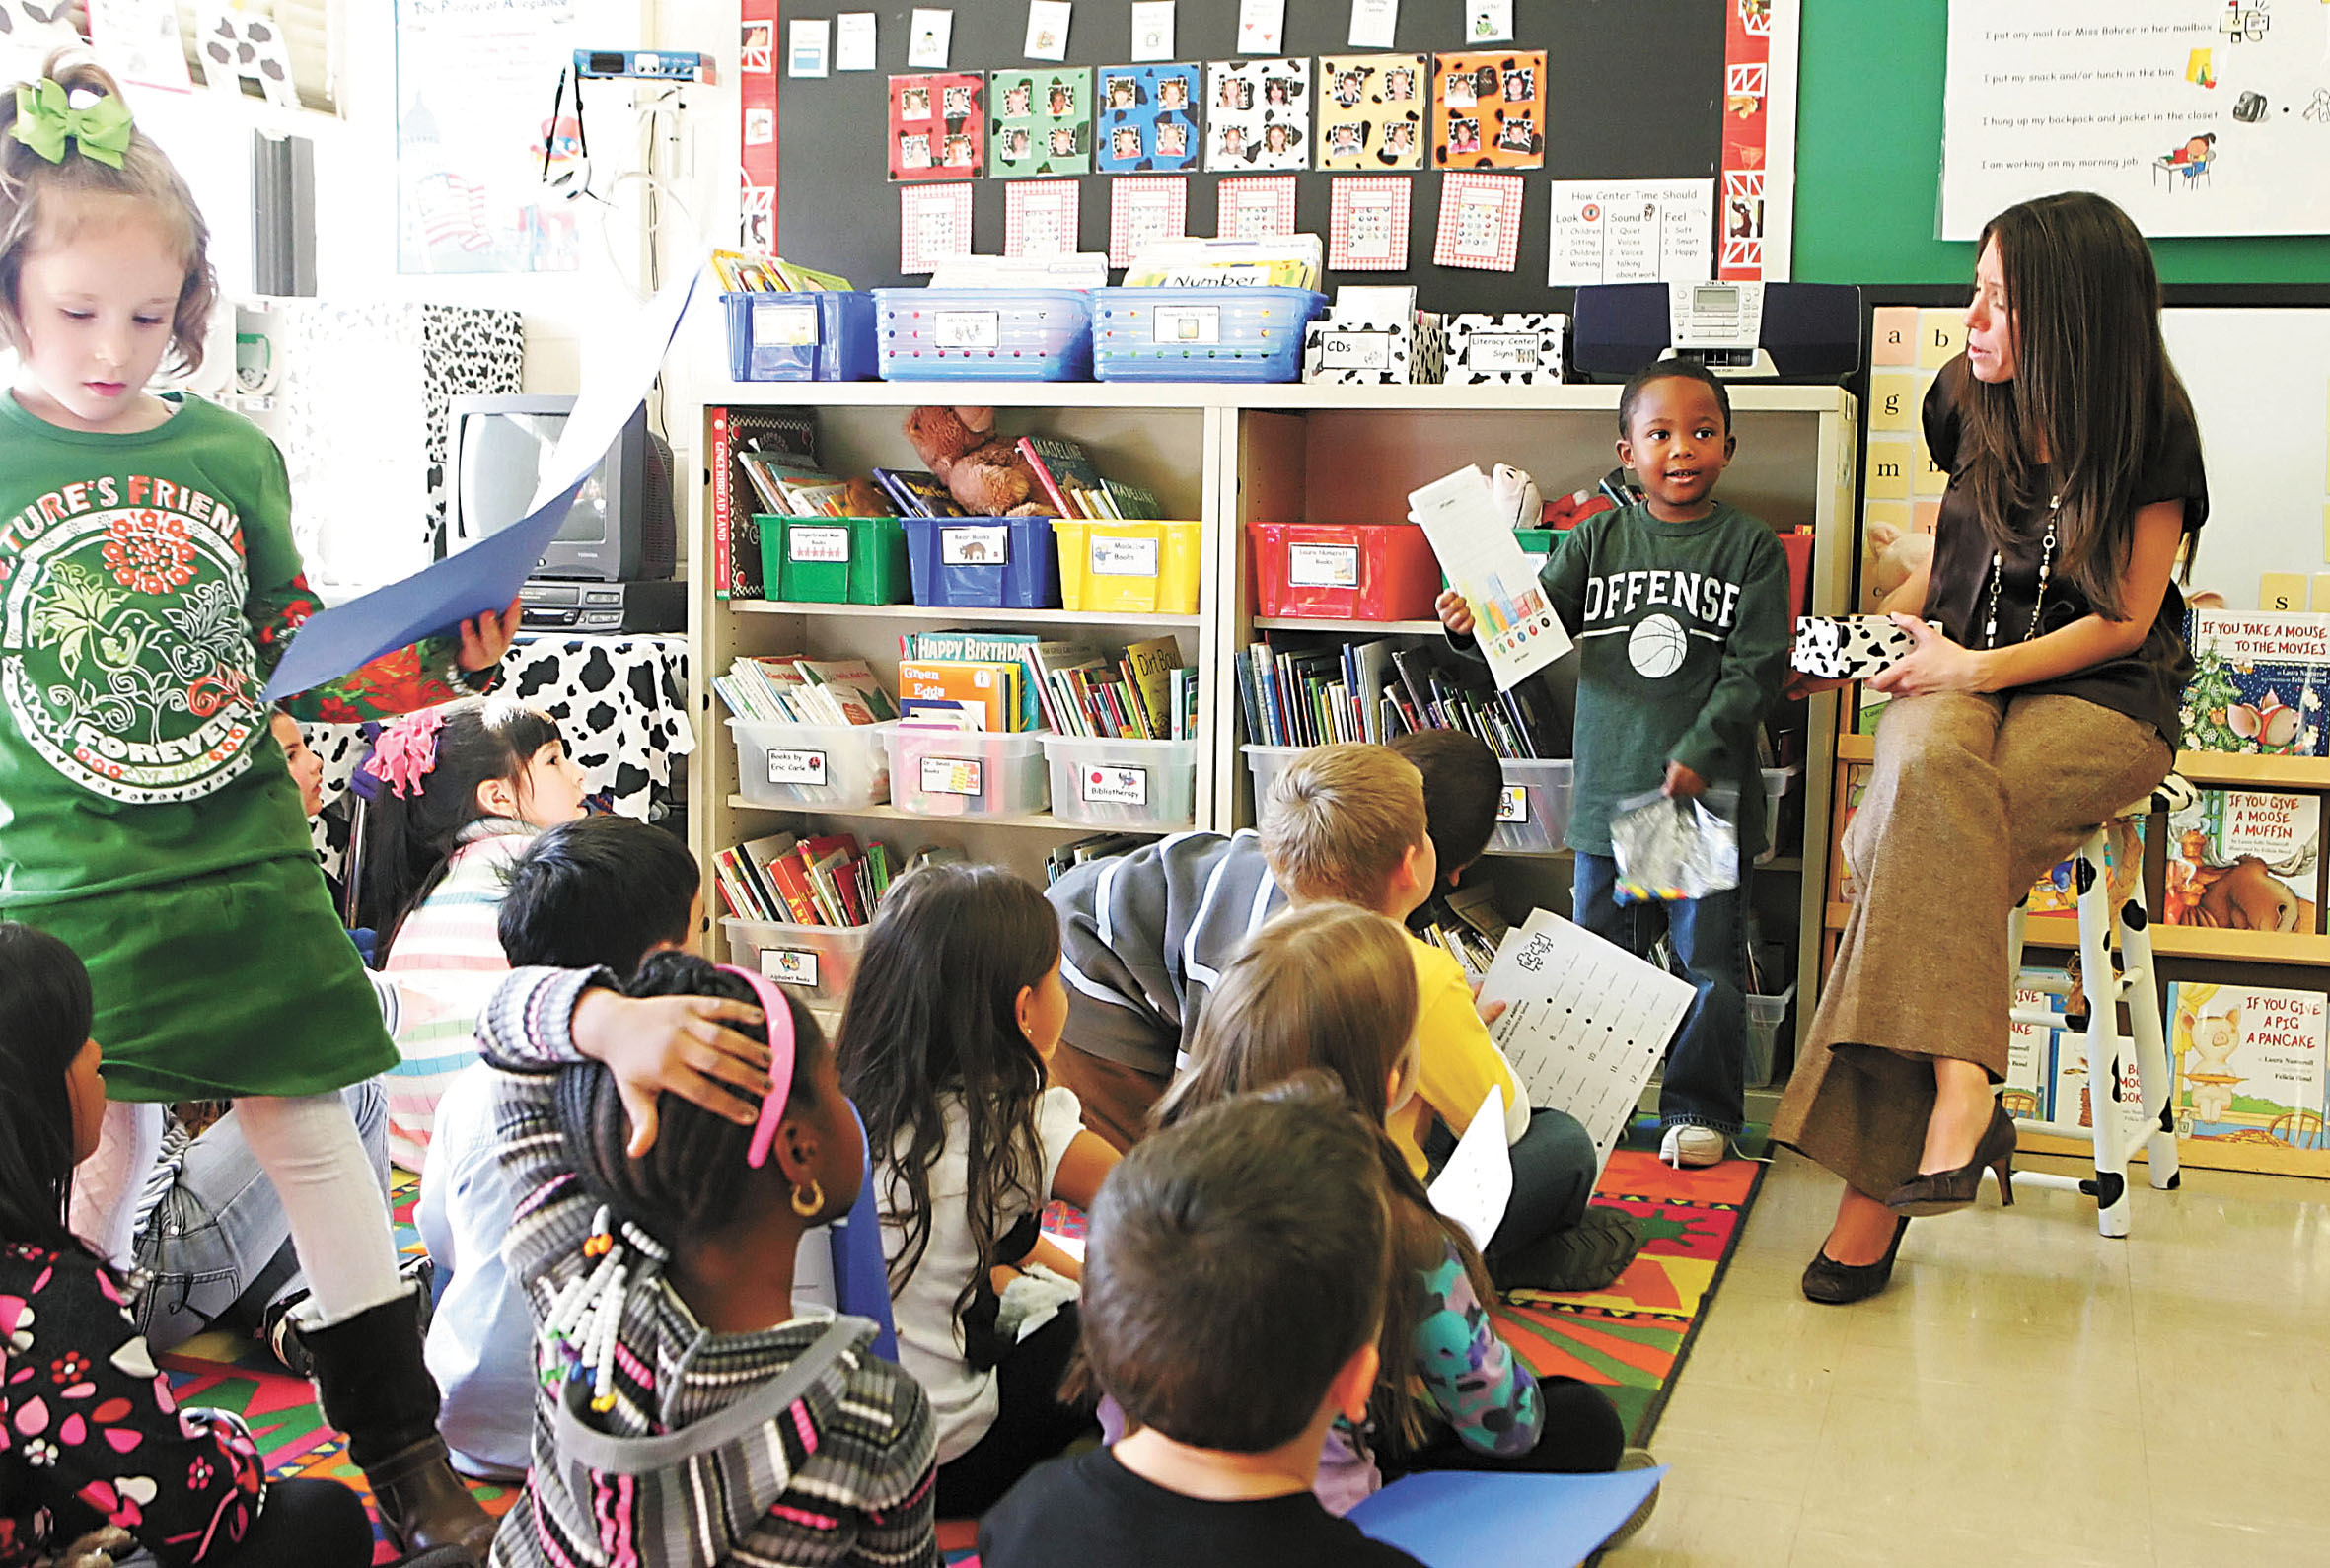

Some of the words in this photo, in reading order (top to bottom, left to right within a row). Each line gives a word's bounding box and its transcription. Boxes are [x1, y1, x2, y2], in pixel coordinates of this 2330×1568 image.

[1994, 31, 2009, 42] put
[2012, 32, 2029, 40] any
[2033, 29, 2053, 37] mail
[2057, 28, 2070, 37] for
[2075, 27, 2098, 36] Miss
[2151, 24, 2169, 33] her
[2173, 23, 2212, 33] mailbox
[1993, 74, 2008, 85] put
[2029, 72, 2056, 82] snack
[2059, 71, 2093, 80] and/or
[2097, 69, 2122, 79] lunch
[2126, 69, 2135, 78] in
[2139, 68, 2155, 78] the
[2158, 67, 2174, 77] bin
[1991, 116, 2013, 128] hung
[2017, 117, 2029, 127] up
[2031, 117, 2045, 126] my
[2049, 114, 2094, 126] backpack
[2097, 112, 2116, 122] and
[2119, 112, 2150, 124] jacket
[2154, 112, 2162, 121] in
[2167, 111, 2183, 120] the
[2006, 159, 2045, 171] working
[2062, 160, 2075, 171] my
[2079, 158, 2119, 168] morning
[2122, 157, 2139, 168] job
[1571, 191, 1593, 202] How
[1596, 191, 1632, 201] Center
[1636, 190, 1659, 200] Time
[1663, 189, 1698, 200] Should
[1556, 213, 1579, 223] Look
[1611, 213, 1641, 223] Sound
[1665, 212, 1687, 222] Feel
[1620, 227, 1641, 236] Quiet
[1675, 249, 1698, 258] Happy
[1570, 260, 1601, 269] Working
[1172, 271, 1260, 287] Number
[1472, 338, 1505, 347] Literacy
[1888, 329, 1902, 345] a
[1934, 329, 1949, 348] b
[1327, 341, 1351, 353] CDs
[1493, 349, 1514, 359] Signs
[1884, 393, 1900, 416] g
[715, 441, 726, 512] GINGERBREAD
[1877, 461, 1900, 477] m
[0, 476, 118, 582] TURE'S
[716, 514, 727, 541] LAND
[2201, 621, 2215, 634] IF
[2218, 622, 2240, 635] YOU
[2242, 623, 2272, 637] TAKE
[2274, 624, 2282, 636] A
[2285, 625, 2328, 640] MOUSE
[918, 637, 964, 661] HAPPY
[965, 638, 1030, 662] BIRTHDA
[2235, 640, 2250, 652] TO
[2253, 641, 2276, 654] THE
[2278, 642, 2326, 656] MOVIES
[1137, 654, 1158, 677] Dirt
[1157, 648, 1177, 672] Boy
[904, 667, 939, 680] Green
[75, 704, 248, 763] FOREVER
[793, 752, 802, 762] by
[1091, 787, 1140, 800] Bibliotherapy
[2228, 794, 2240, 807] IF
[2245, 795, 2267, 808] YOU
[2270, 796, 2299, 811] GIVE
[2235, 811, 2243, 822] A
[2248, 811, 2292, 824] MOOSE
[2232, 824, 2240, 836] A
[2245, 824, 2293, 839] MUFFIN
[2246, 996, 2260, 1010] IF
[2263, 998, 2287, 1011] YOU
[2290, 999, 2321, 1015] GIVE
[2264, 1016, 2272, 1028] A
[2275, 1016, 2299, 1031] PIG
[2246, 1033, 2255, 1044] A
[2258, 1033, 2316, 1049] PANCAKE
[1587, 1052, 1597, 1062] 10
[1610, 1065, 1618, 1074] 11
[1629, 1074, 1638, 1084] 12
